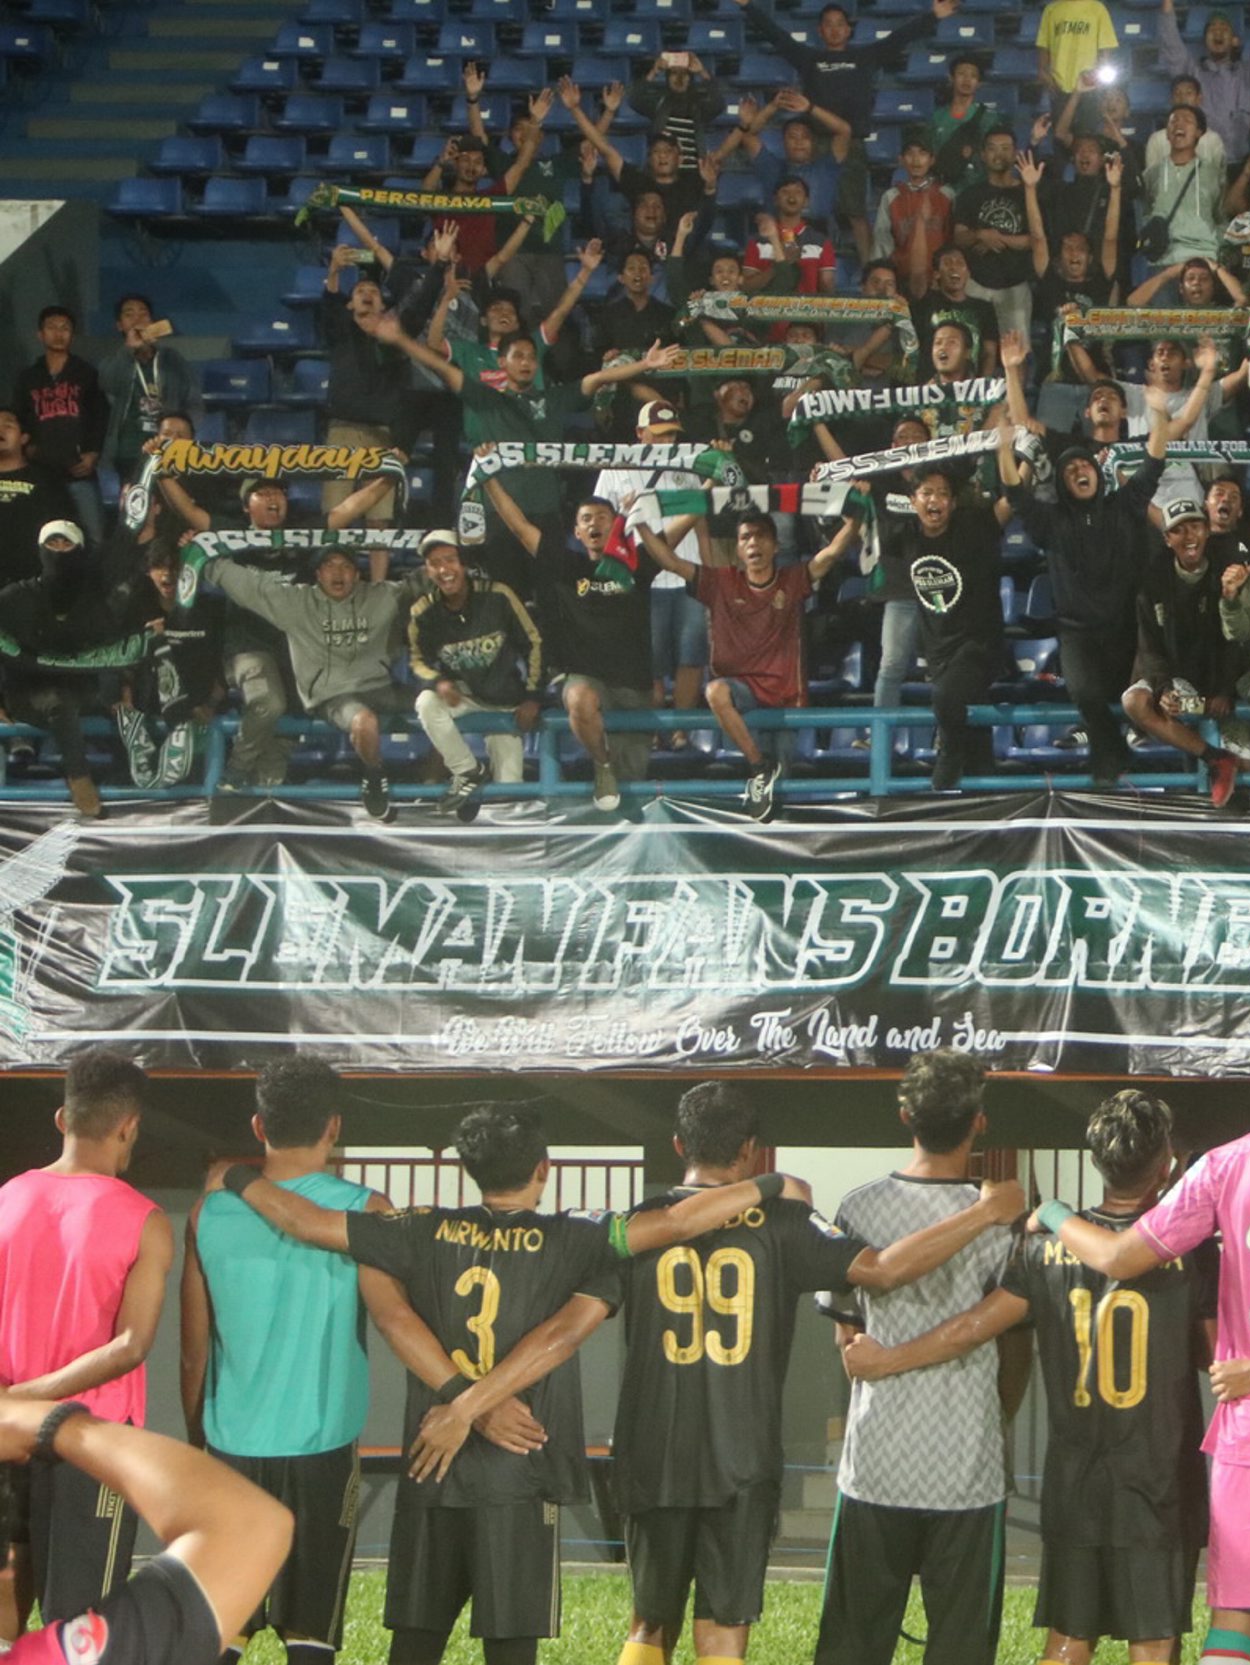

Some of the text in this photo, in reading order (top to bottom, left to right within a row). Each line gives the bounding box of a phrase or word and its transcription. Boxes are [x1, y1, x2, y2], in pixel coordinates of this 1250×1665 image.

[360, 188, 492, 209] PERSEBAYA
[690, 348, 786, 371] SLEMAN
[155, 439, 386, 479] Awaydays
[535, 442, 711, 469] SLEMAN
[884, 424, 1003, 470] SLEMA
[283, 529, 422, 549] SLEMA
[676, 1012, 741, 1057] Over
[750, 1007, 797, 1051] The
[807, 1008, 879, 1059] Land
[886, 1016, 941, 1052] and
[952, 1011, 1007, 1053] Sea
[451, 1265, 501, 1381] 3
[656, 1246, 756, 1366] 99
[1068, 1288, 1150, 1409] 10
